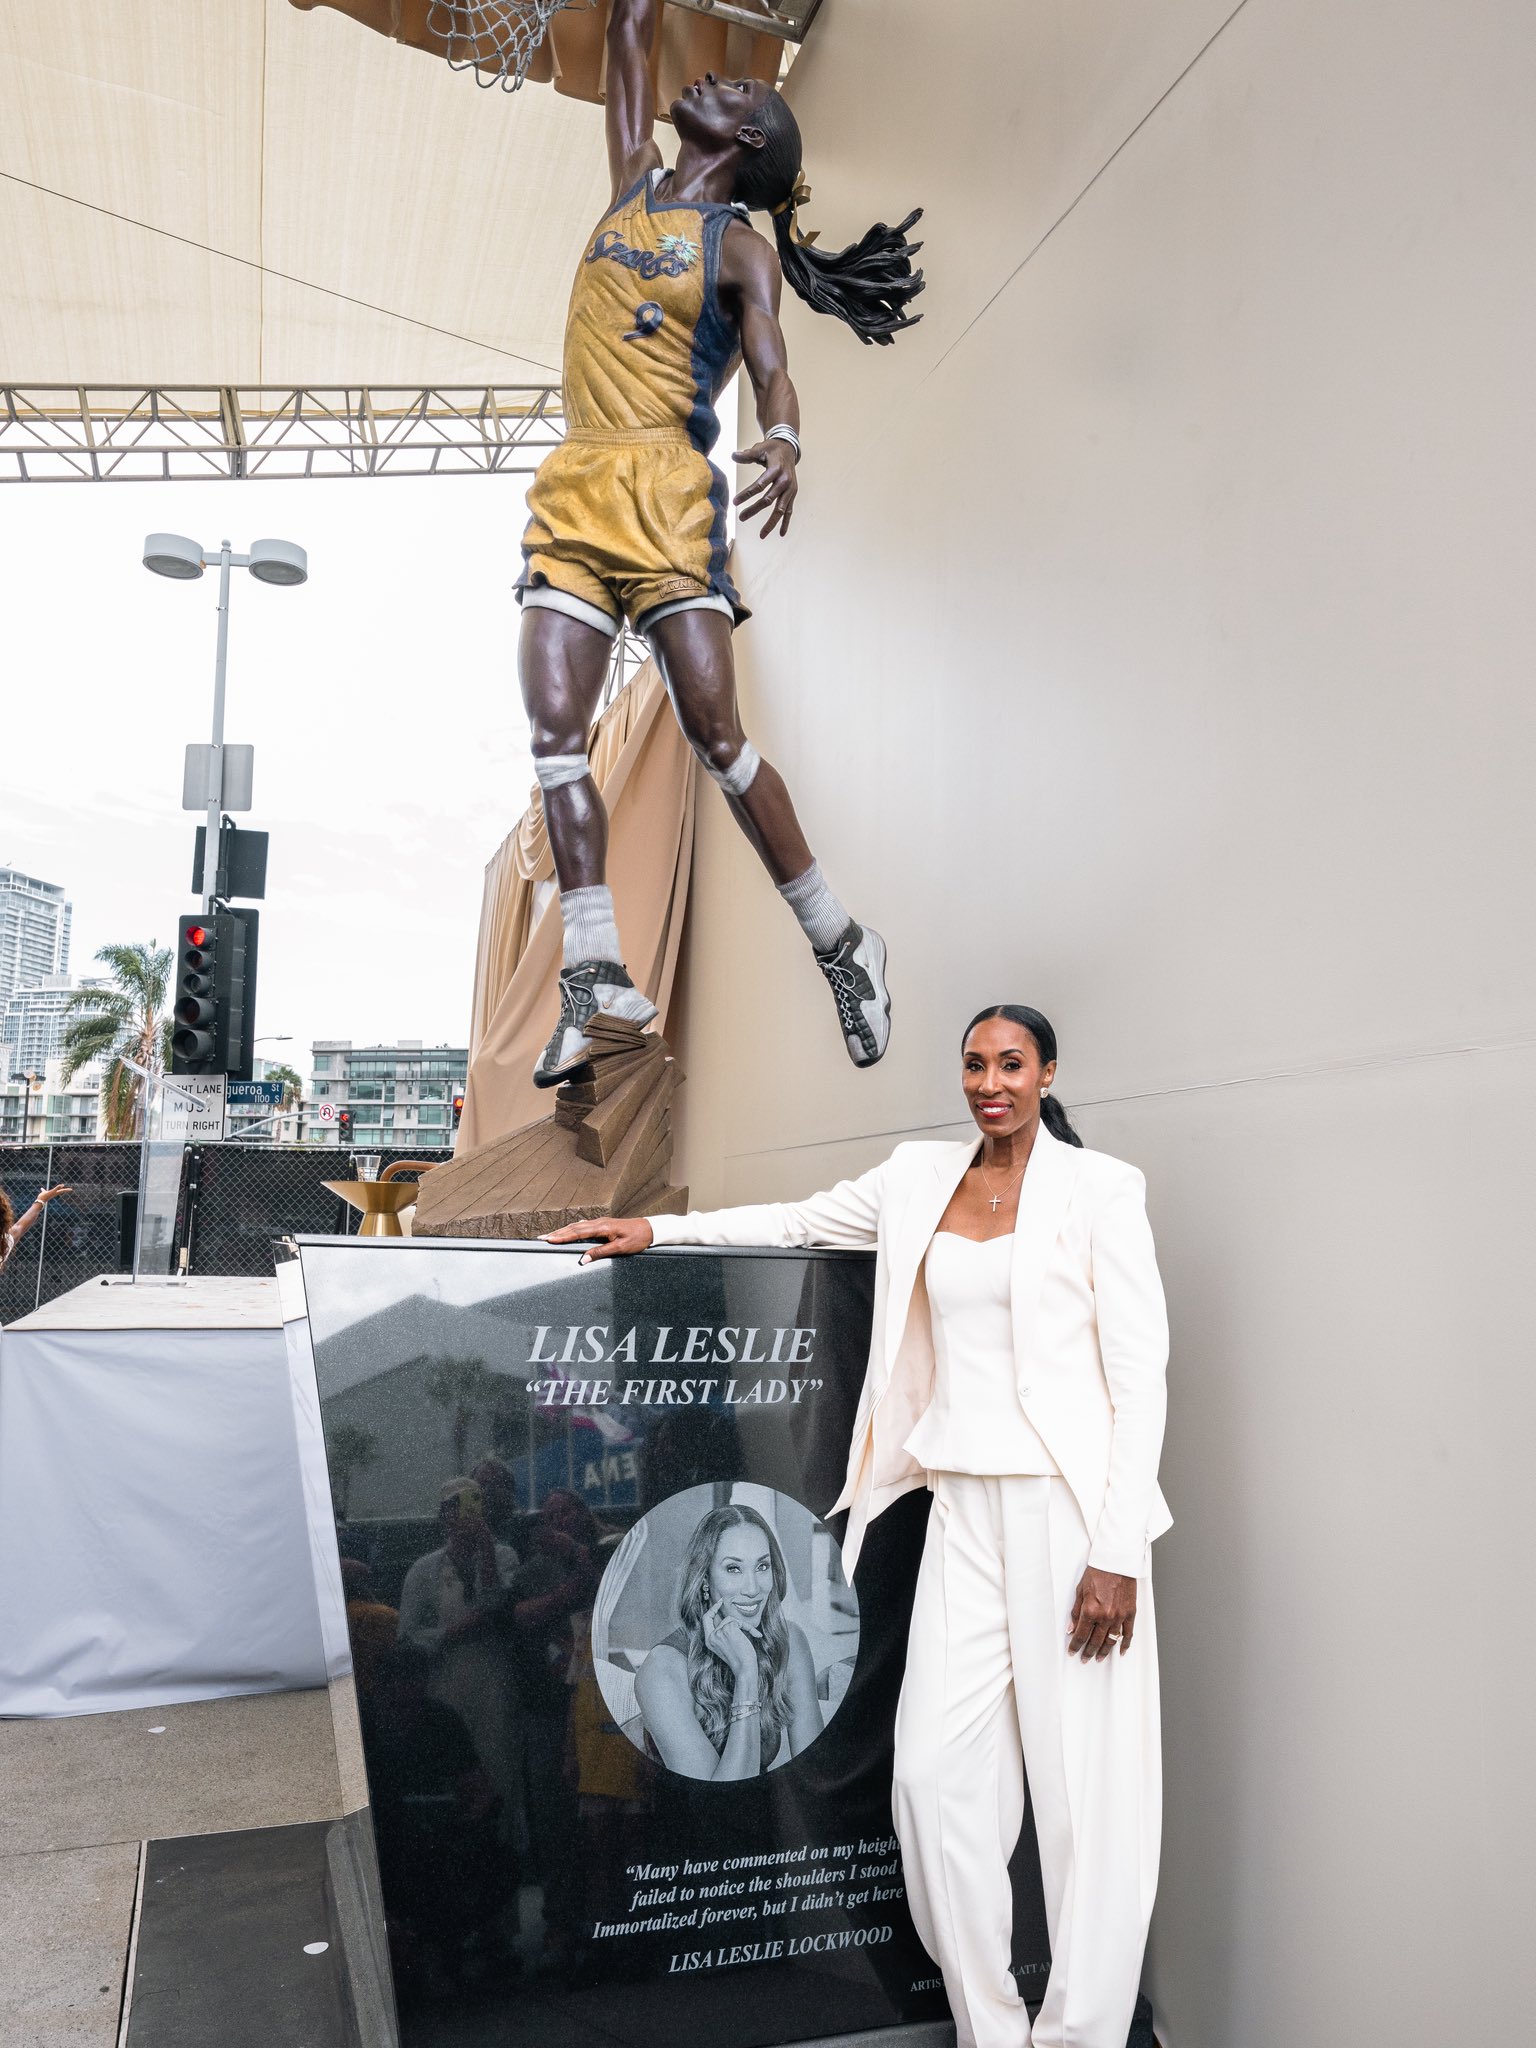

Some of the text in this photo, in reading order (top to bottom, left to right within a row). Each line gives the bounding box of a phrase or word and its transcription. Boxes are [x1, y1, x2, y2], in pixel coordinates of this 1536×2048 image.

[622, 301, 664, 341] 9
[196, 1084, 222, 1094] LANE
[254, 1094, 280, 1103] 1100 S
[271, 1083, 280, 1092] St
[165, 1120, 220, 1131] TURN RIGHT
[525, 1325, 817, 1364] LISA LESLIE
[525, 1378, 824, 1406] “THE FIRST LADY”
[626, 1863, 679, 1882] “Many
[682, 1858, 719, 1876] have
[722, 1845, 808, 1871] commented
[810, 1846, 829, 1860] on
[832, 1844, 855, 1860] my
[628, 1886, 678, 1913] failed
[679, 1887, 695, 1902] to
[698, 1879, 745, 1900] notice
[748, 1875, 772, 1893] the
[775, 1867, 846, 1890] shoulders
[848, 1863, 858, 1881] I
[859, 1859, 898, 1879] stood
[591, 1885, 904, 1939] Immortalized forever, but I didn’t get here
[668, 1925, 894, 1973] LISA LESLIE LOCKWOOD
[910, 1977, 944, 1993] ARTIS
